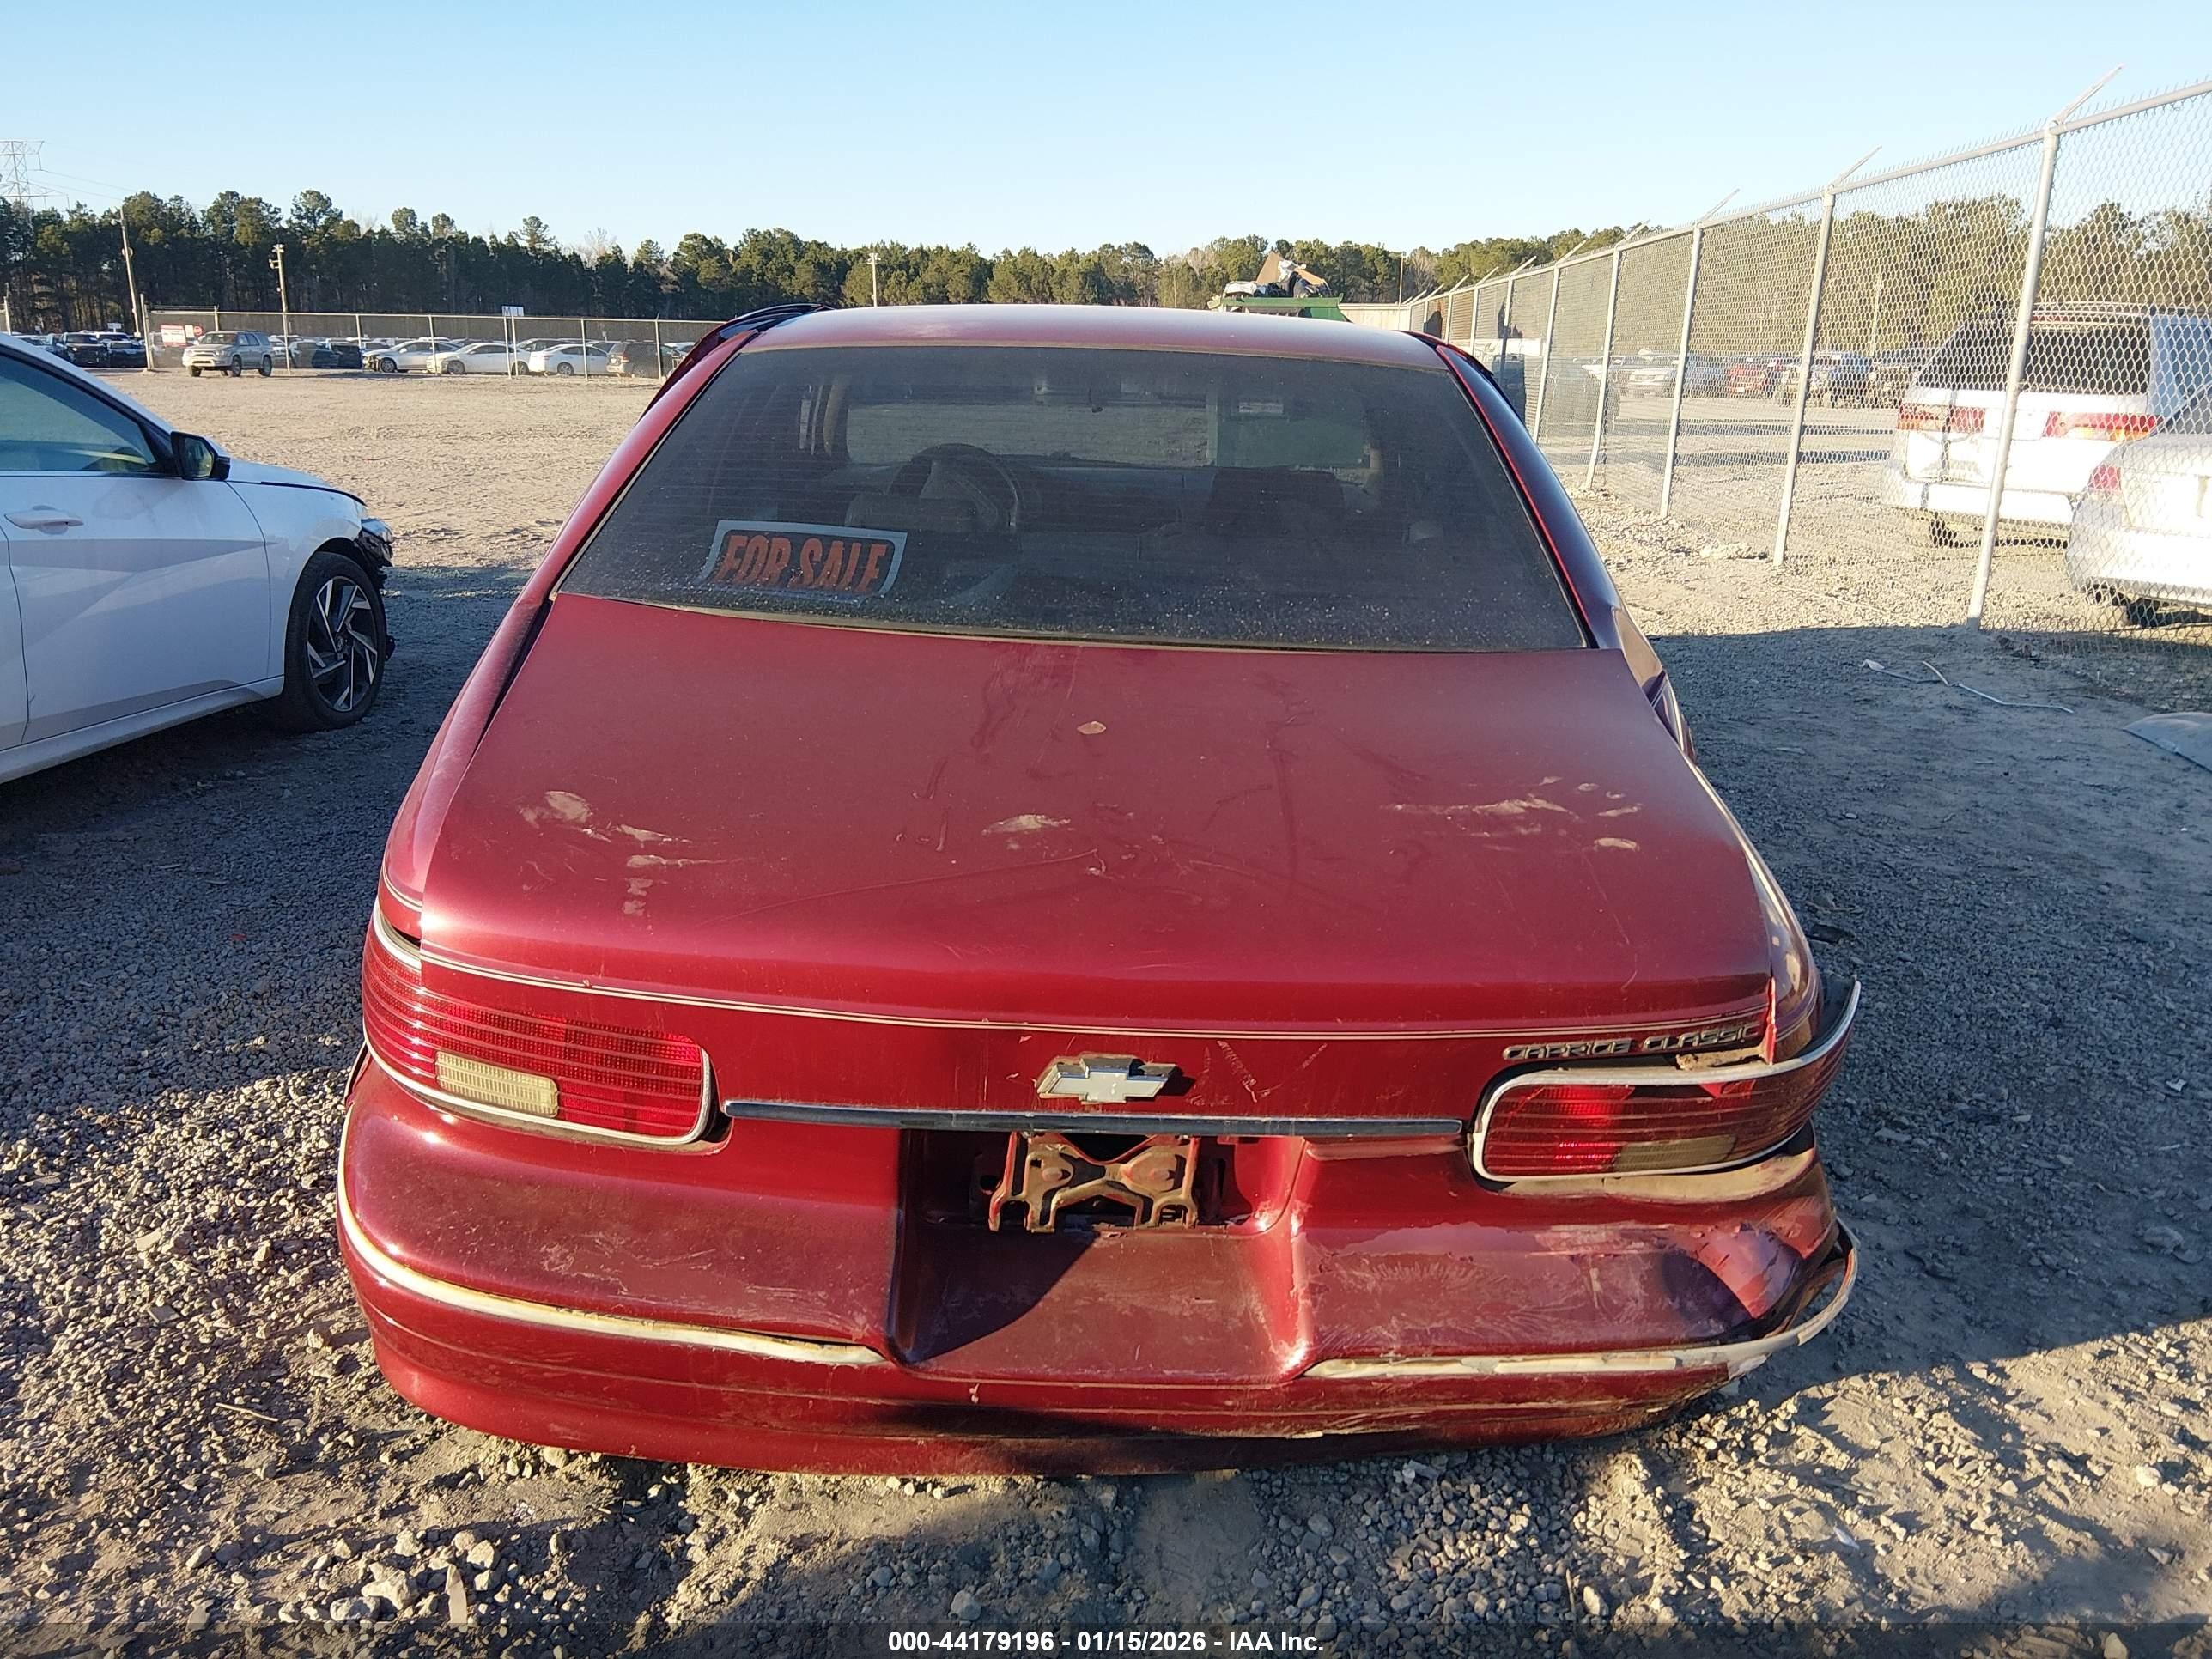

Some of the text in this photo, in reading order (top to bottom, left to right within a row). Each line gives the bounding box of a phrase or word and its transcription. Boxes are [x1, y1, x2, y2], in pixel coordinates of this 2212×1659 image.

[712, 534, 887, 593] FOR SALE
[1503, 1024, 1761, 1060] CAPRICE CLASSIC
